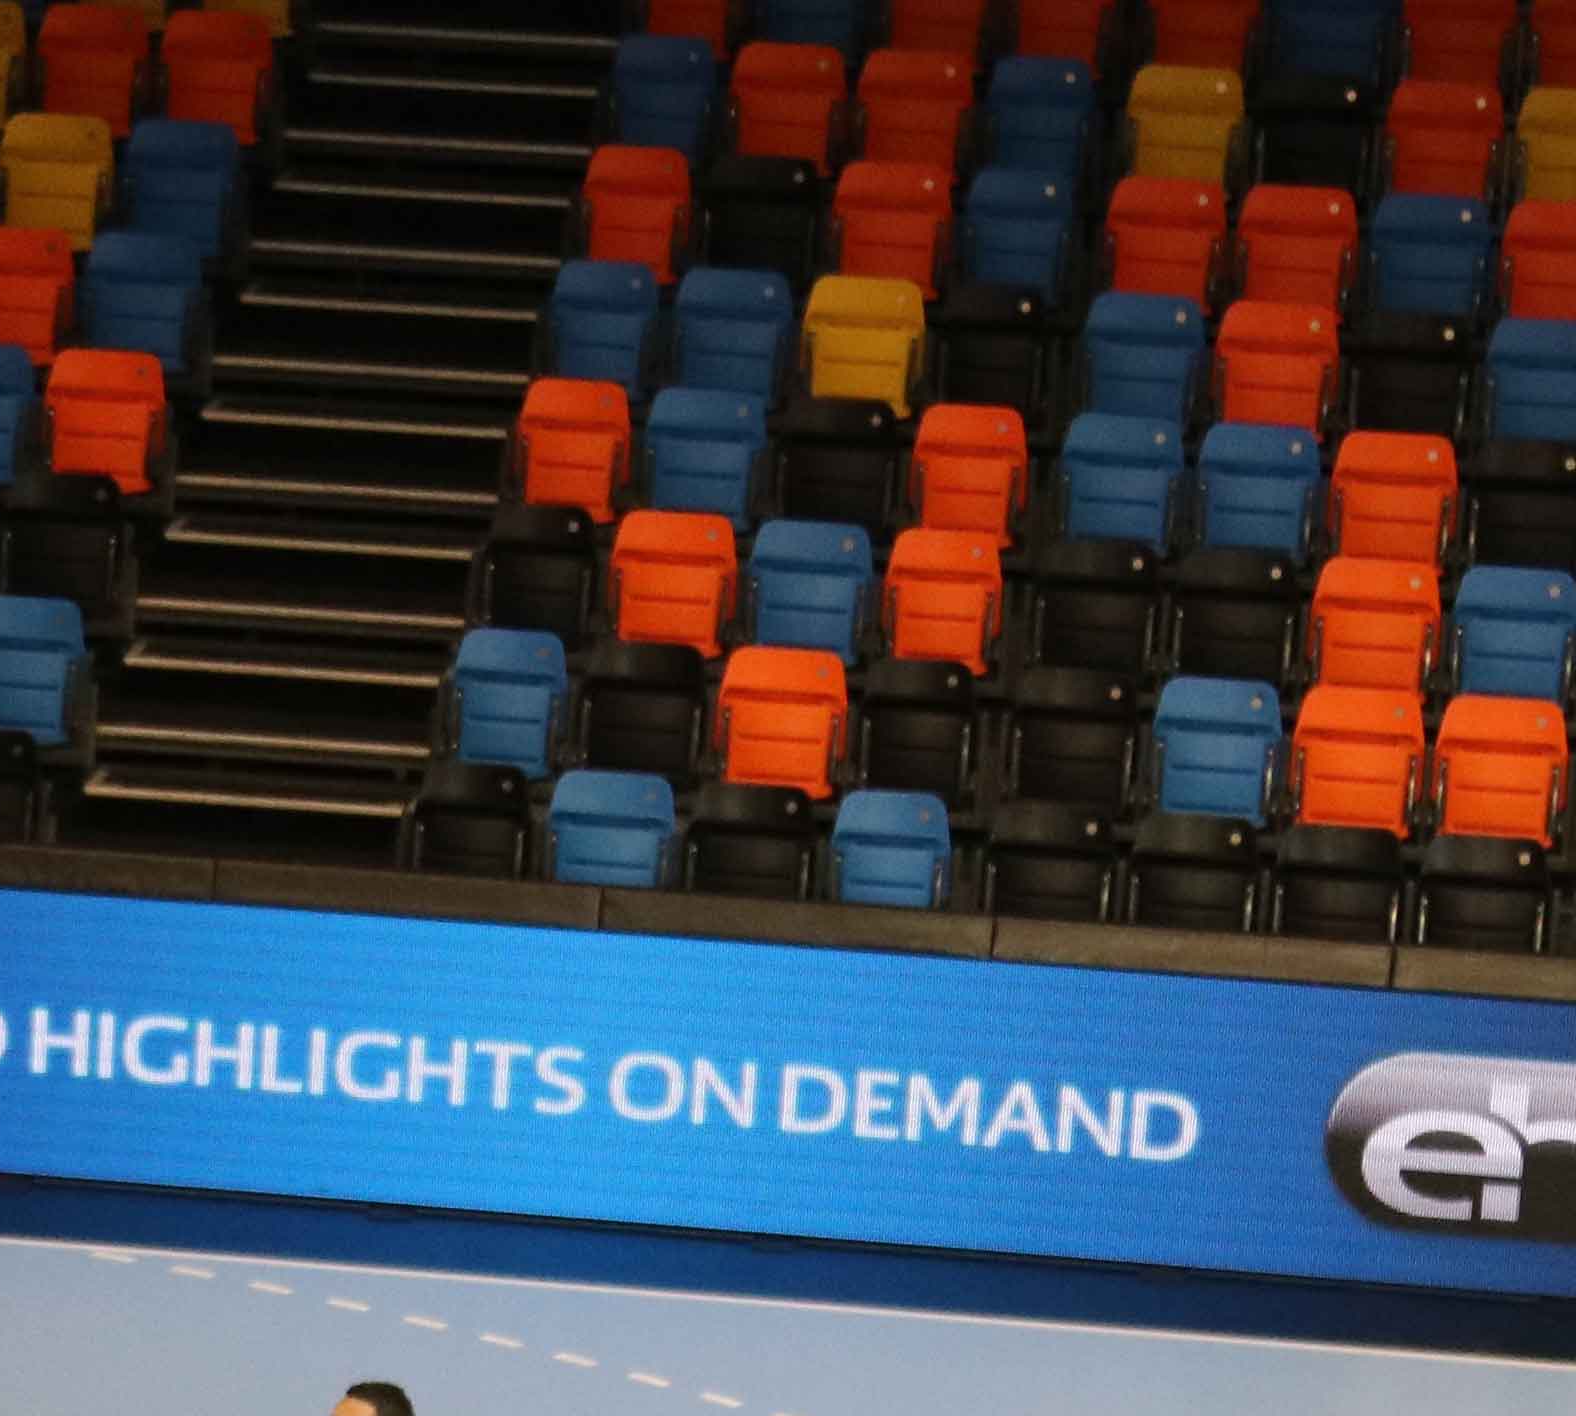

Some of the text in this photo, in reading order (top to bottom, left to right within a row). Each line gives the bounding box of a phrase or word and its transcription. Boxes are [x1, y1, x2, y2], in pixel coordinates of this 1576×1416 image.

[31, 1008, 586, 1115] HIGHLIGHTS
[608, 1052, 758, 1128] ON
[779, 1063, 1198, 1162] DEMAND
